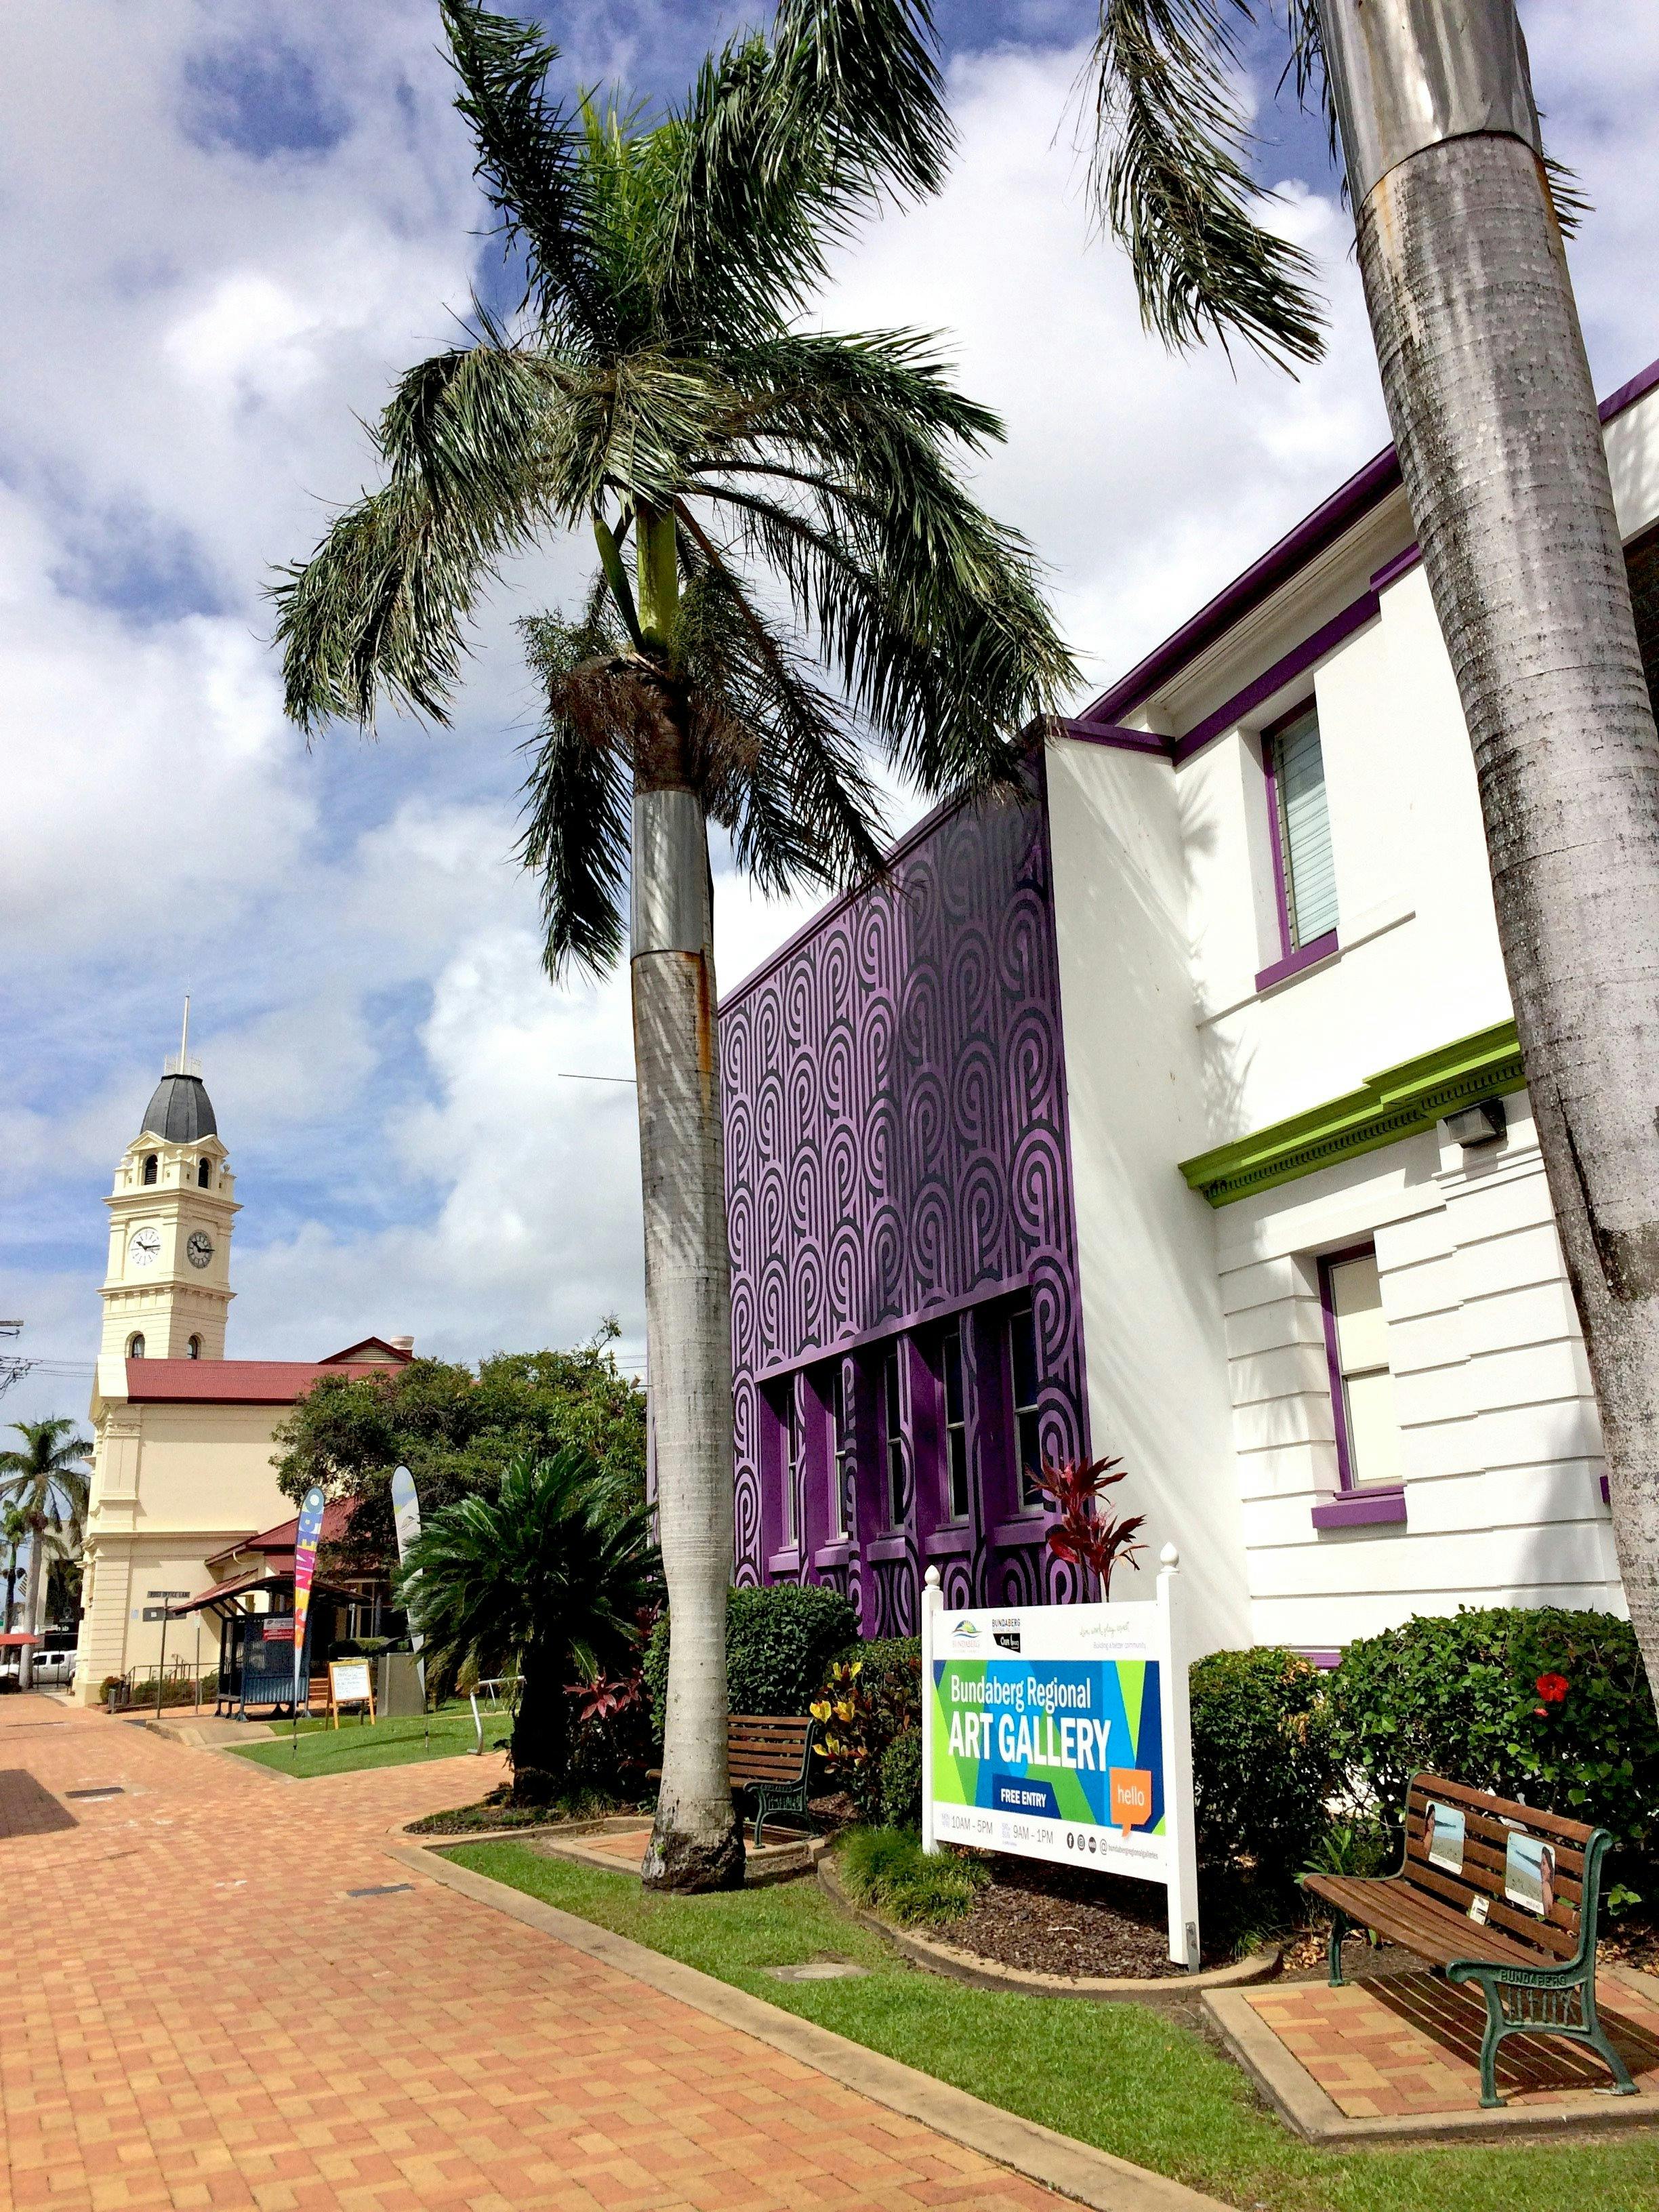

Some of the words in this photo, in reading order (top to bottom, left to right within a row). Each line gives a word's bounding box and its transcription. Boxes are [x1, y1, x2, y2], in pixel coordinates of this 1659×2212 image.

[951, 1675, 1025, 1713] Bundaberg
[1027, 1677, 1091, 1714] Regional
[947, 1711, 994, 1760] ART
[998, 1713, 1111, 1772] GALLERY
[1000, 1788, 1020, 1805] FREE
[1021, 1790, 1047, 1807] ENTRY
[1117, 1784, 1145, 1807] hello
[951, 1816, 970, 1830] 10AM
[977, 1820, 993, 1835] 5PM
[1013, 1824, 1029, 1840] 9AM
[1037, 1828, 1054, 1844] 1PM
[1500, 1969, 1567, 1986] BUNDABERG
